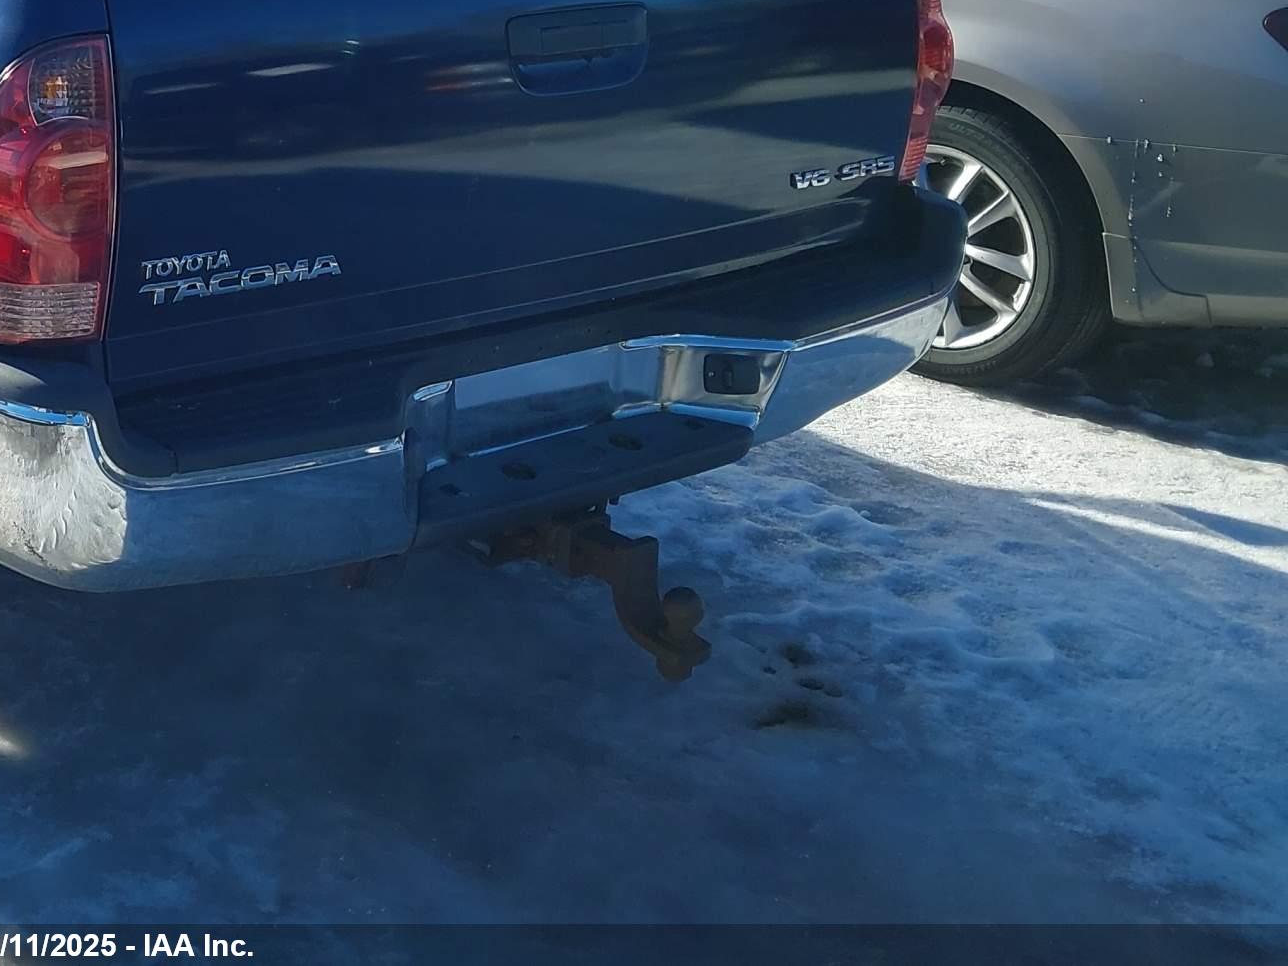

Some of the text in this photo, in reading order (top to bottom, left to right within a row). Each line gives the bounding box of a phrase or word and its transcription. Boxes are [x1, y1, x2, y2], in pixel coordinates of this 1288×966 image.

[790, 155, 895, 189] V6 SR5
[138, 254, 342, 306] TACOMA
[141, 249, 232, 280] TOYOTA
